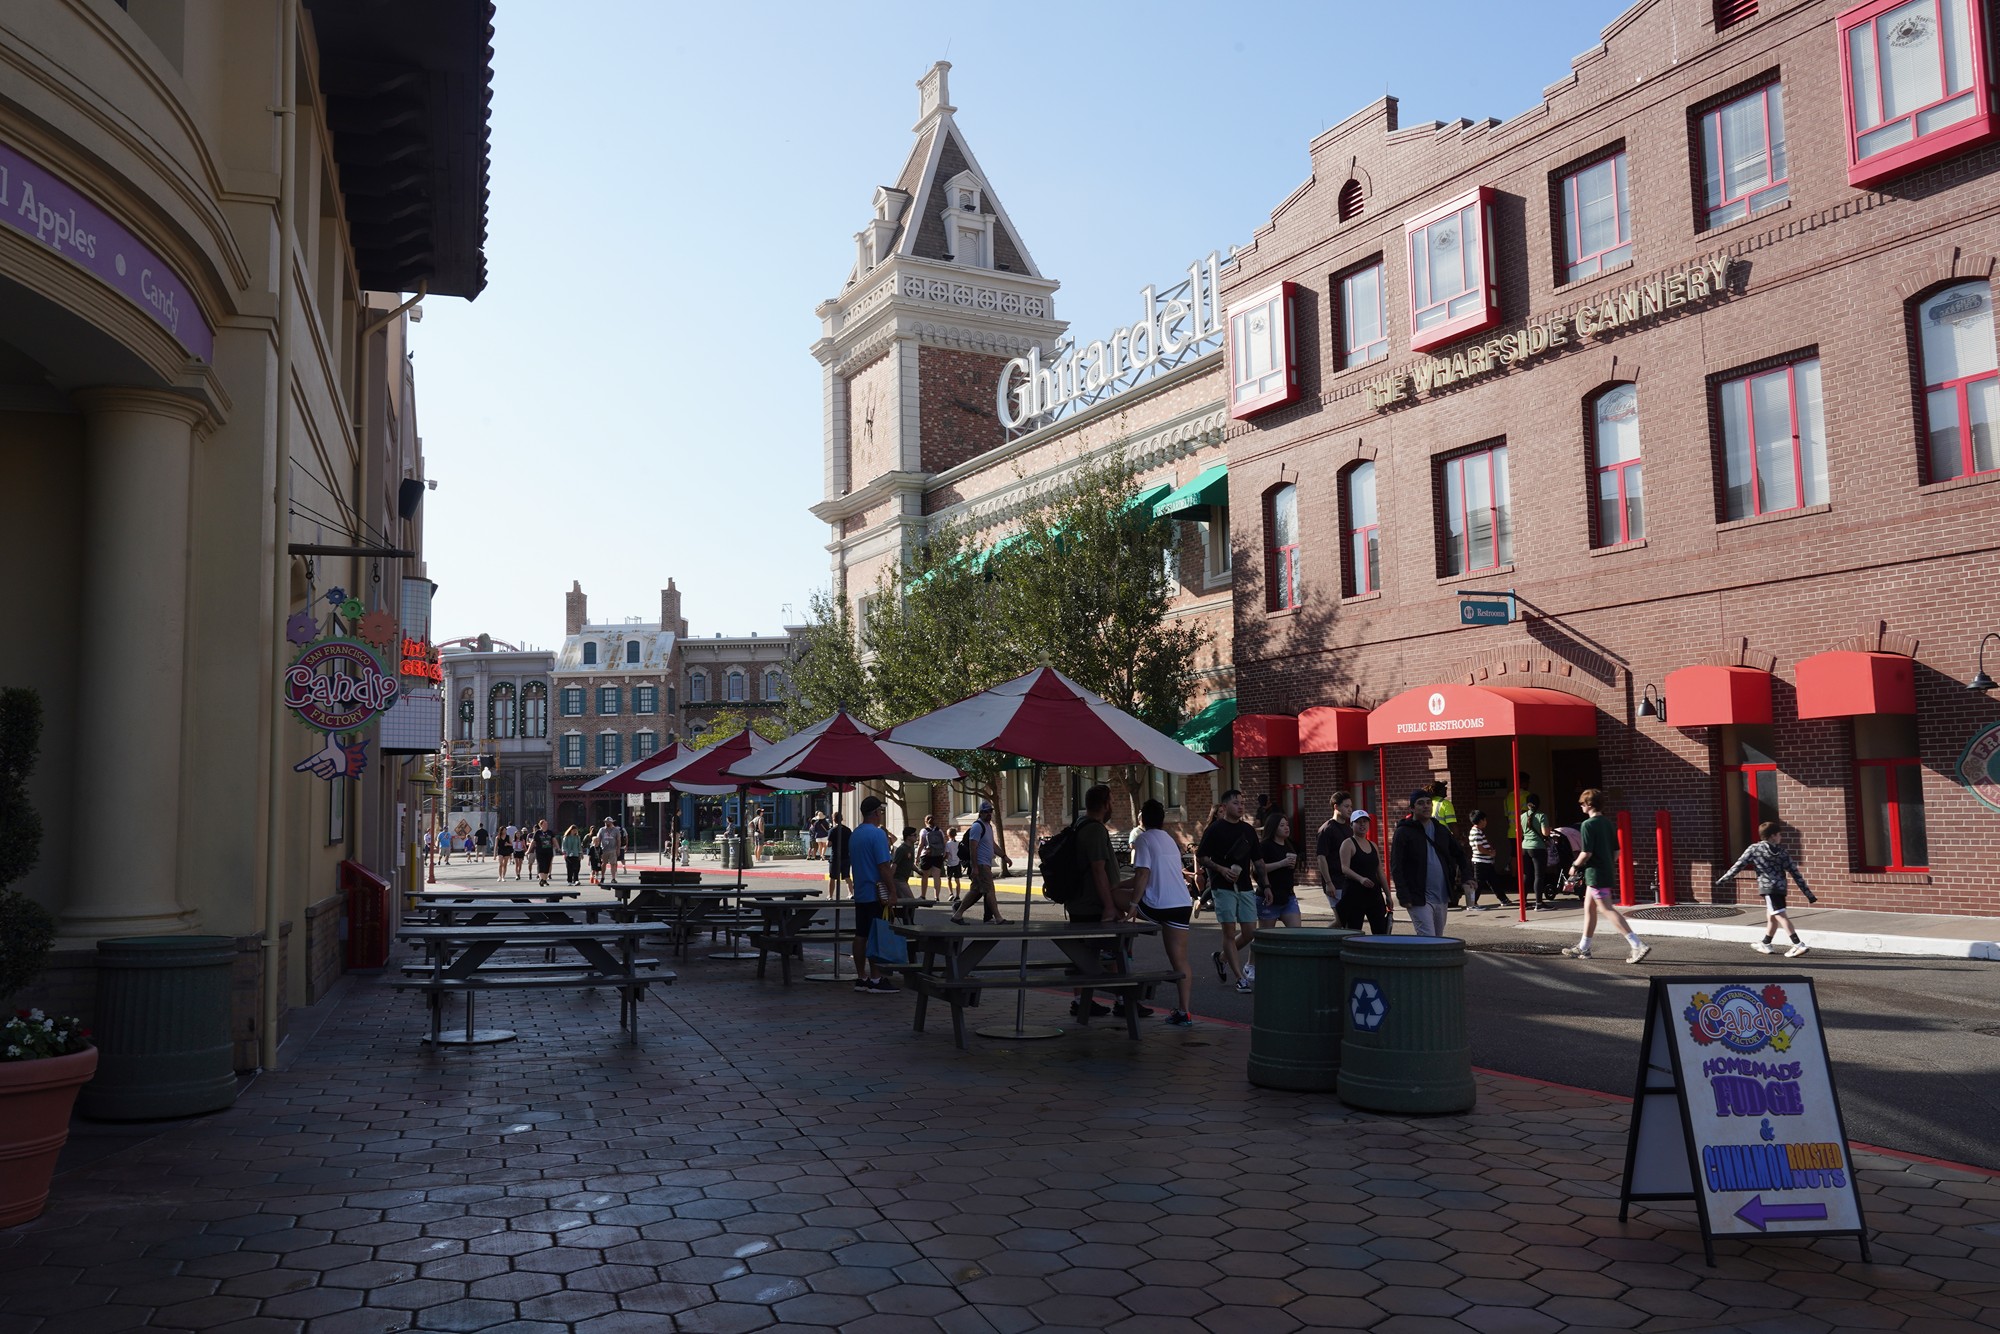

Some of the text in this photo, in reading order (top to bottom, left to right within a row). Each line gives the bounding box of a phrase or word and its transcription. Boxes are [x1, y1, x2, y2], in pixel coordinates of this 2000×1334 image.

[18, 180, 97, 260] Apples
[141, 268, 180, 334] Candy
[997, 247, 1238, 429] Ghirardell
[1363, 255, 1733, 411] THE WHARFSIDE CANNERY
[1477, 608, 1506, 618] Restrooms
[305, 646, 371, 666] SAN FRANCISCO
[400, 659, 429, 677] GER
[285, 664, 398, 710] Candy
[309, 708, 365, 726] FACTORY
[1397, 718, 1485, 734] PUBLIC RESTROOMS
[1478, 780, 1500, 789] OMEN
[1719, 992, 1757, 1006] SAN FRANCISCO
[1698, 1001, 1785, 1039] Candy
[1729, 1033, 1761, 1046] FACTORY
[1703, 1056, 1803, 1081] HOMEMADE
[1710, 1075, 1804, 1117] FUDGE
[1759, 1118, 1775, 1141] &
[1785, 1142, 1844, 1170] ROASTED
[1702, 1143, 1793, 1193] CINNAMON
[1791, 1168, 1847, 1190] NUTS
